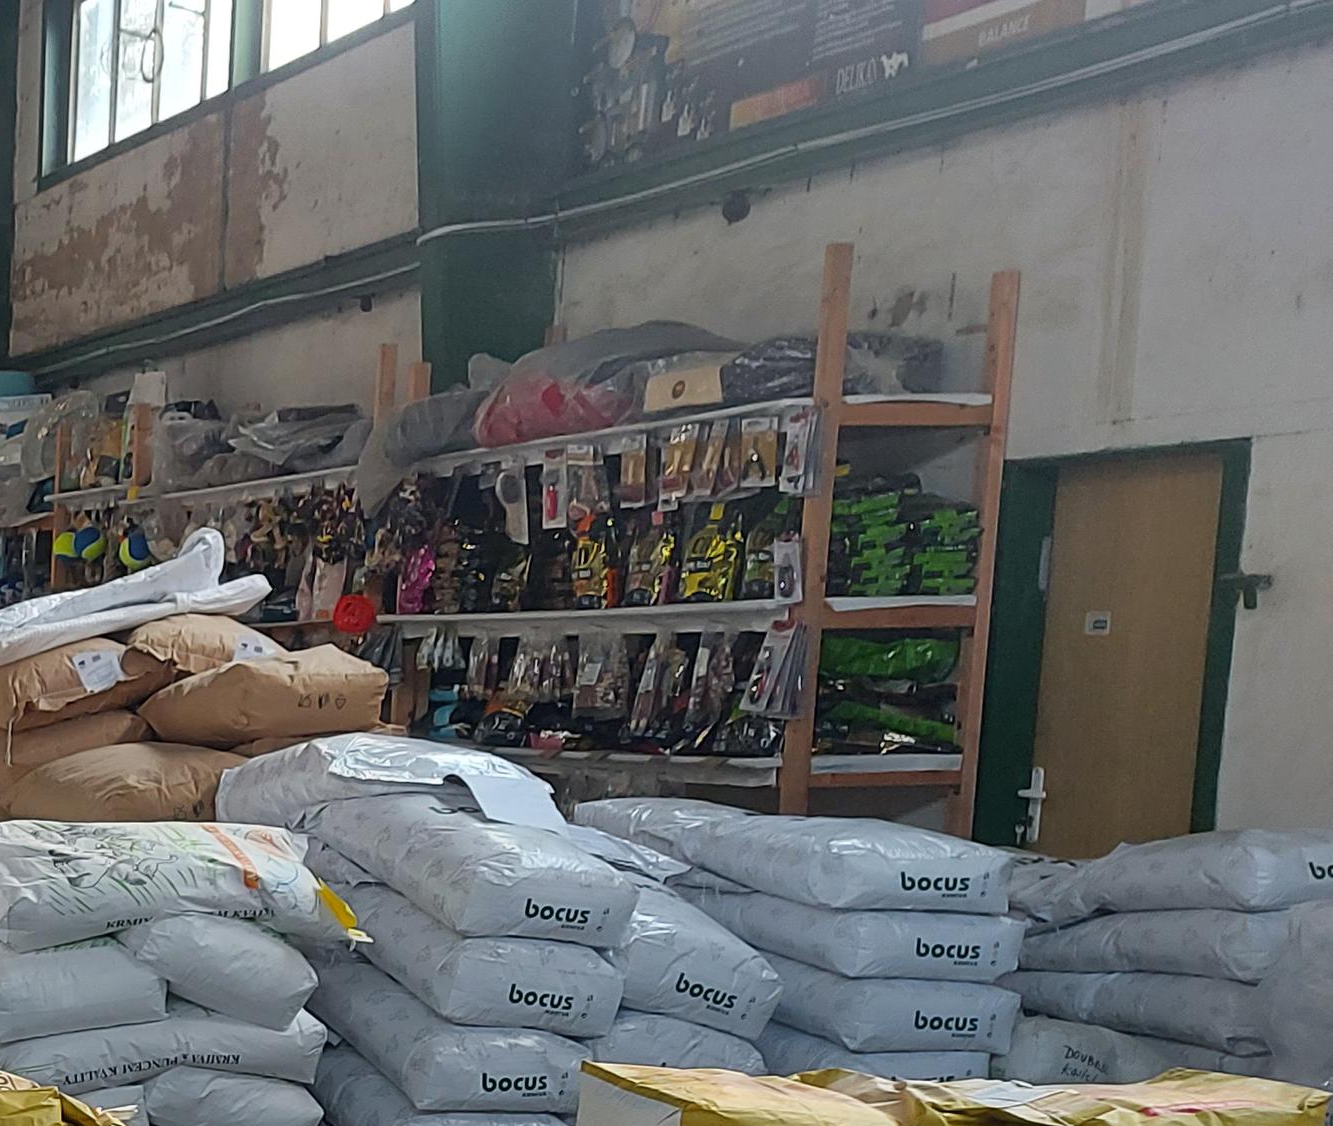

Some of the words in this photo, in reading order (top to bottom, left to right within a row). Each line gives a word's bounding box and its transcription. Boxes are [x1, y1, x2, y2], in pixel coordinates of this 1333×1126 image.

[901, 872, 970, 891] bocus
[525, 899, 590, 924] bocus
[106, 917, 153, 928] KRMIV
[916, 938, 981, 959] bocus
[509, 984, 573, 1010] bocus
[675, 972, 737, 1009] bocus
[914, 1011, 978, 1031] bocus
[123, 1056, 178, 1075] PUNCEM
[62, 1066, 118, 1085] KVALITY
[482, 1073, 547, 1092] bocus
